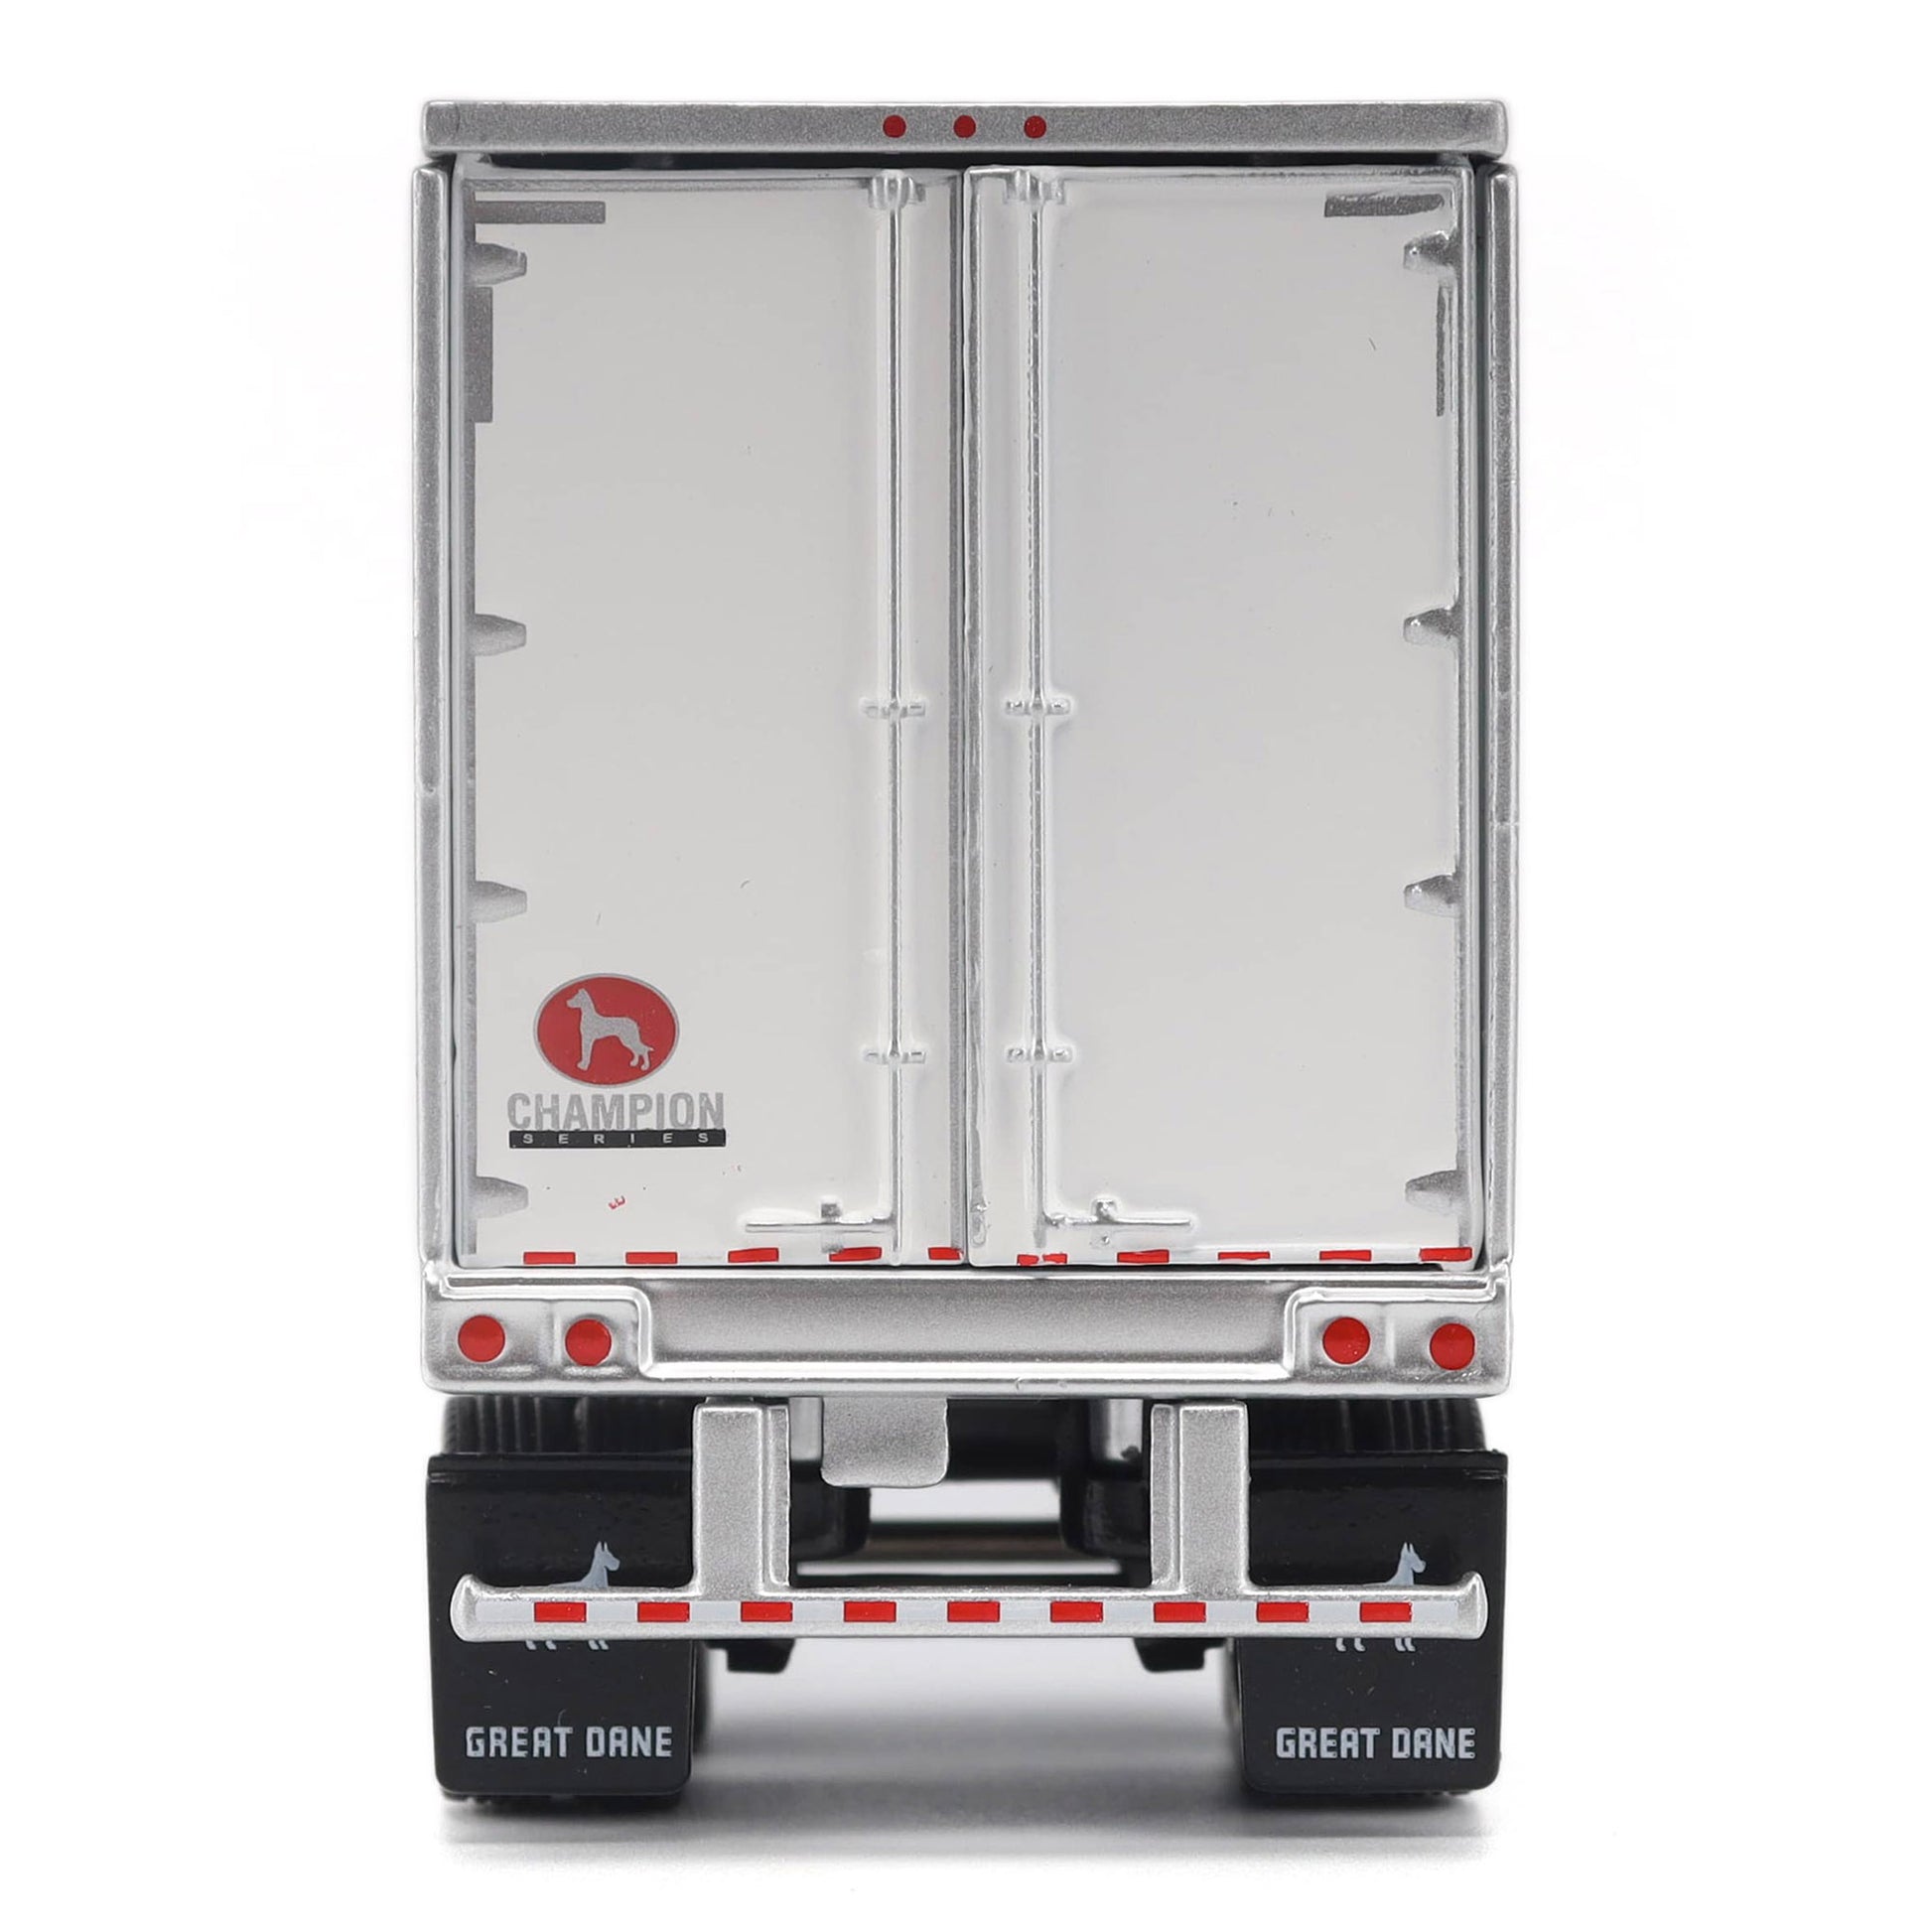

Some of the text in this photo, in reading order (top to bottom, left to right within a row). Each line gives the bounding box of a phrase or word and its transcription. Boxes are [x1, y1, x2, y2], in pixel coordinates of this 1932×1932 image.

[507, 1092, 724, 1130] CHAMPION
[522, 1132, 709, 1145] SERIES
[466, 1725, 673, 1758] GREAT DANE
[1276, 1726, 1476, 1759] GREAT DANE
